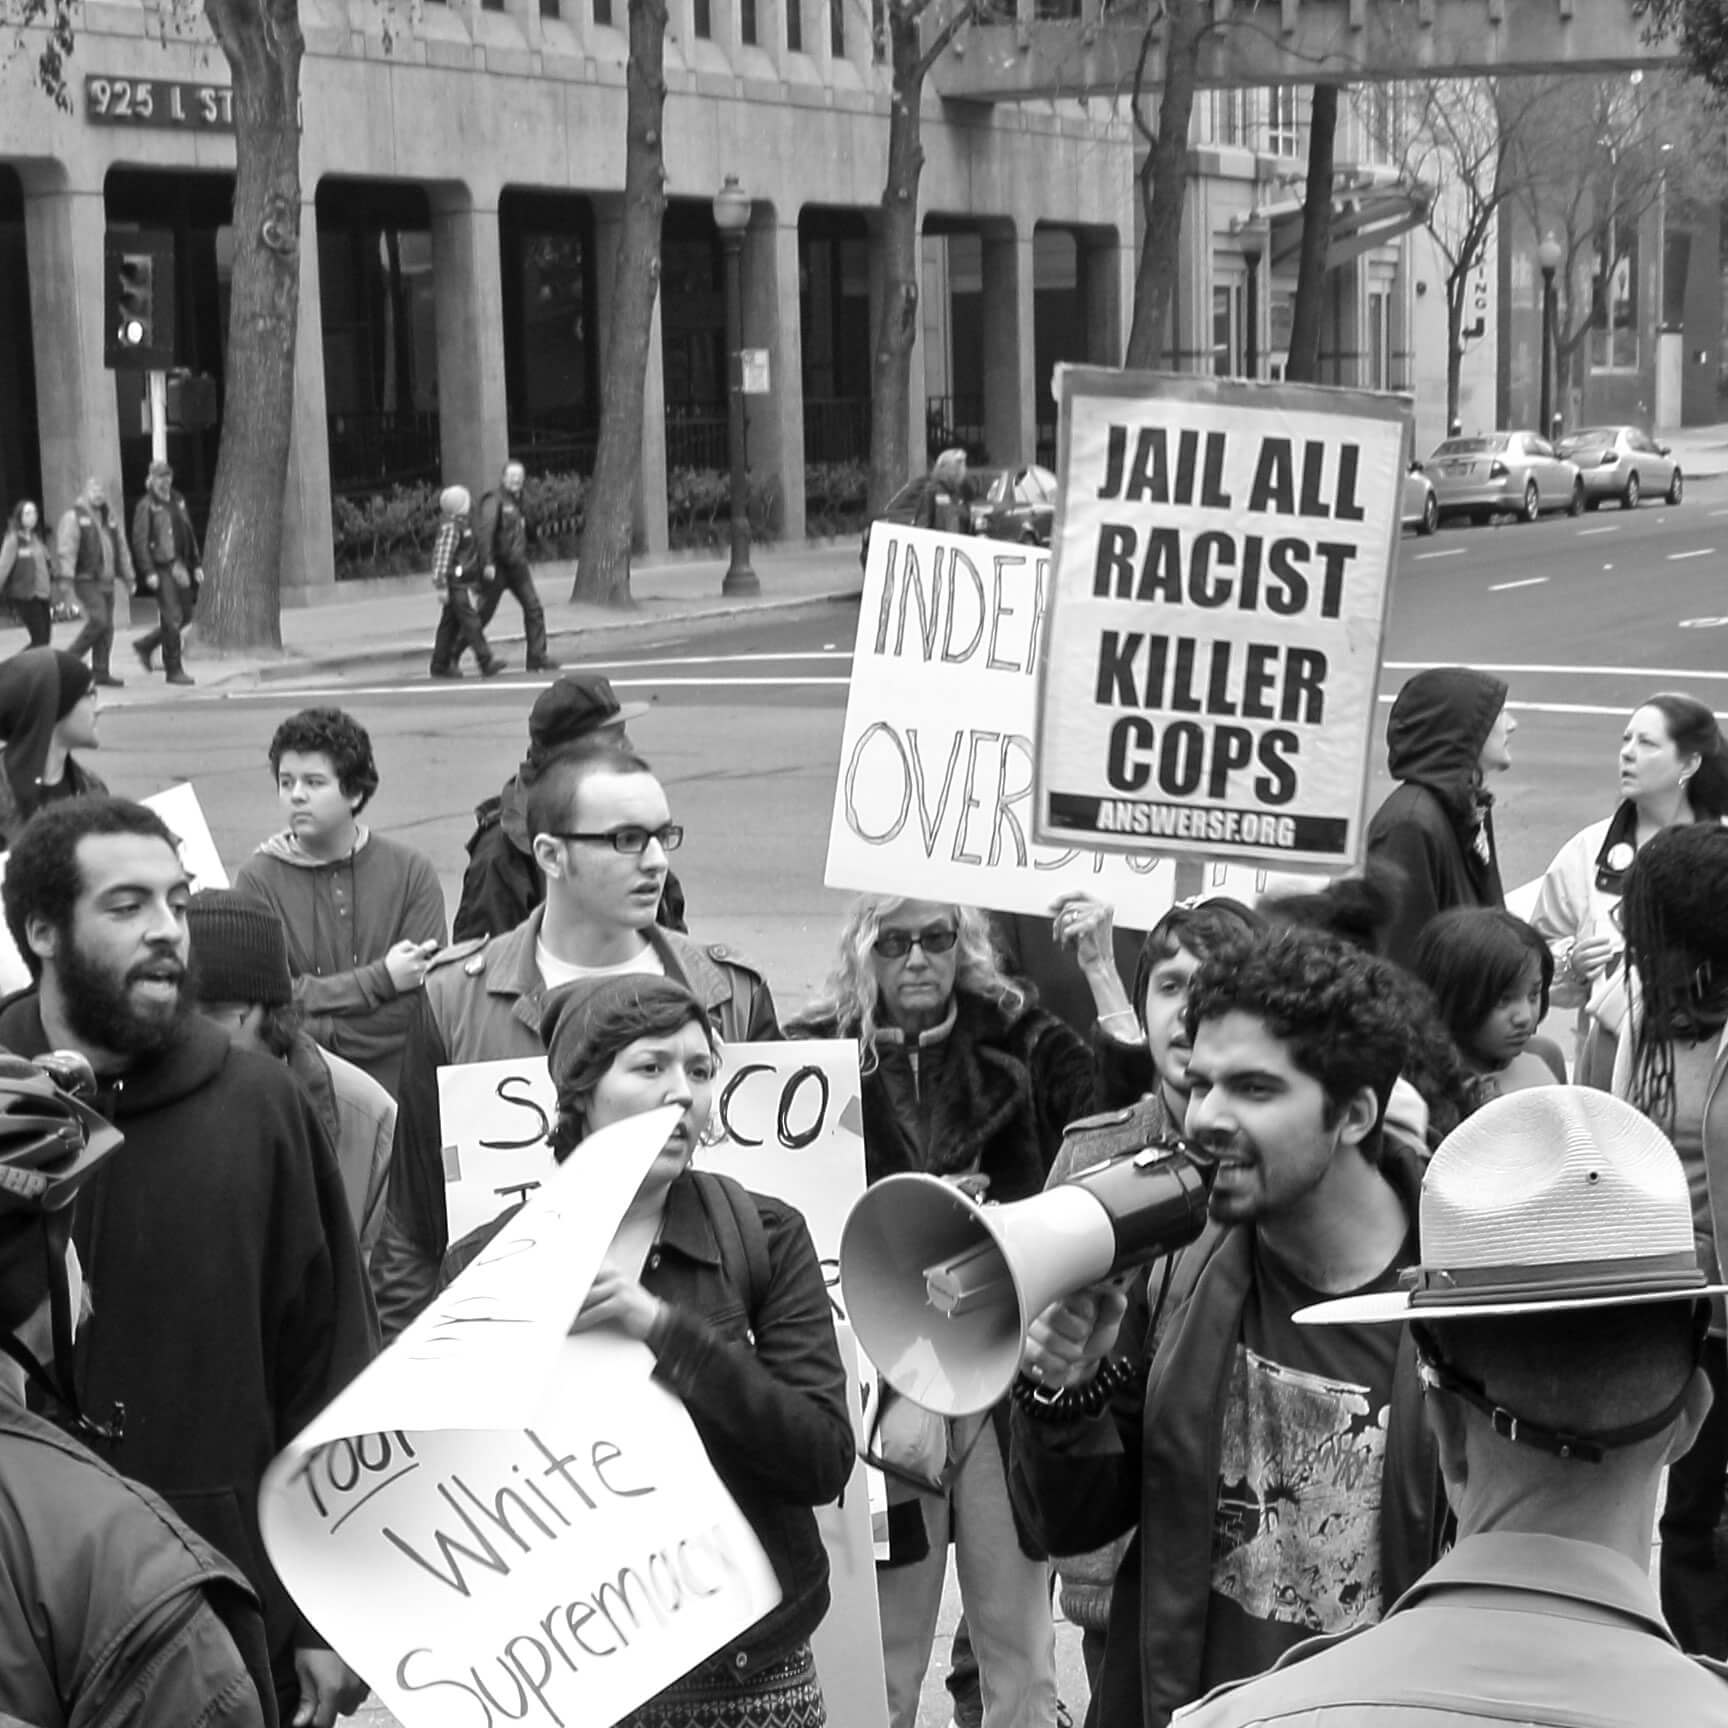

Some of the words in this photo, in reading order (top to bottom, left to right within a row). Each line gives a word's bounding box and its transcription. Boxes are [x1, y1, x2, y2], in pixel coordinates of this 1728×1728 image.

[90, 79, 154, 119] 925
[1097, 423, 1231, 509] JAIL
[1248, 437, 1366, 521] ALL
[1092, 522, 1358, 619] RACIST
[1094, 629, 1330, 725] KILLER
[1106, 715, 1301, 806] COPS
[1096, 799, 1296, 850] ANSWERSF.ORG
[382, 1427, 658, 1598] White
